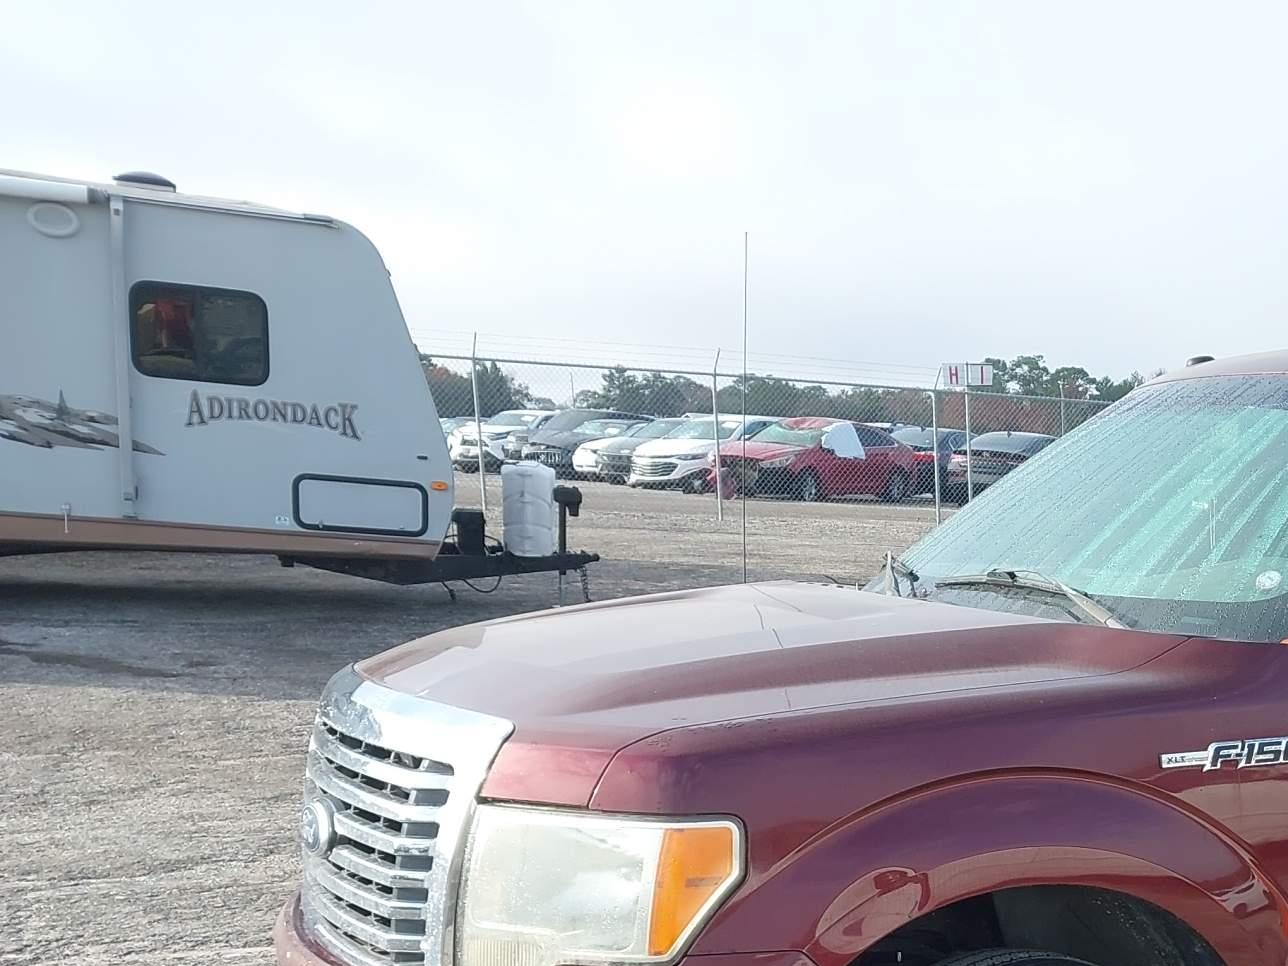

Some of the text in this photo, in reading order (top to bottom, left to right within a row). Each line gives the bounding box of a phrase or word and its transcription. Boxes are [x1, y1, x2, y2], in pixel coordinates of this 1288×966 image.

[948, 365, 959, 385] H
[184, 388, 362, 442] ADIRONDACK
[1166, 755, 1187, 766] XLT
